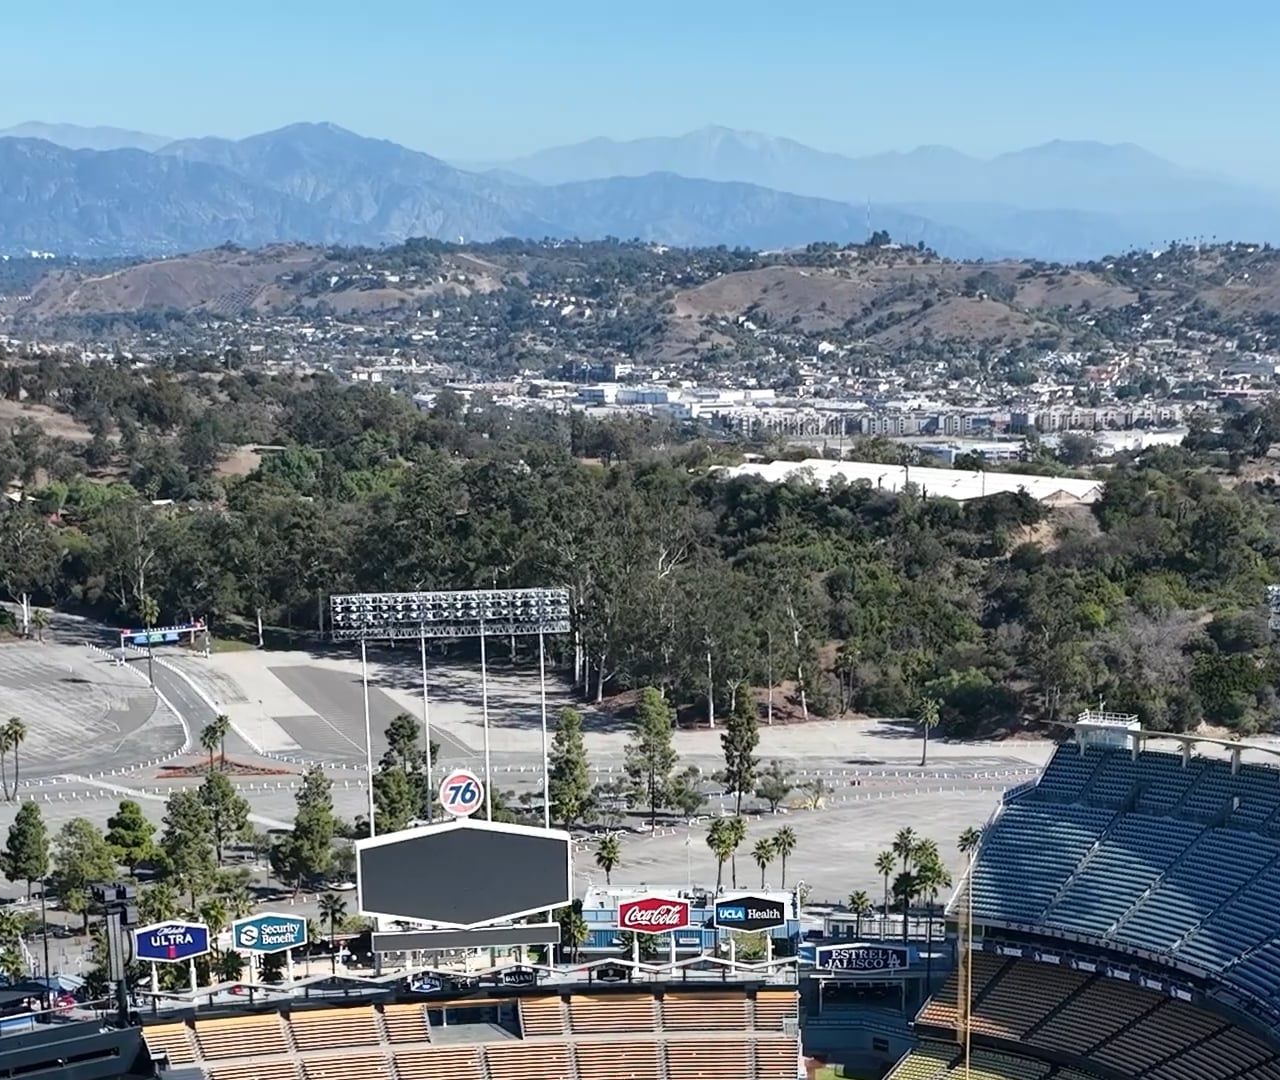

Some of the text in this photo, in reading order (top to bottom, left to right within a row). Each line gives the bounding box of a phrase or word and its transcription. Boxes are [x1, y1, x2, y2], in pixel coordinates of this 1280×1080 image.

[448, 781, 477, 805] 76
[624, 905, 683, 926] Coca-Cola
[719, 908, 781, 919] UCLA Health
[260, 922, 300, 936] Security
[151, 935, 193, 947] ULTRA
[261, 933, 297, 946] Benefit
[824, 958, 884, 969] JALISCO
